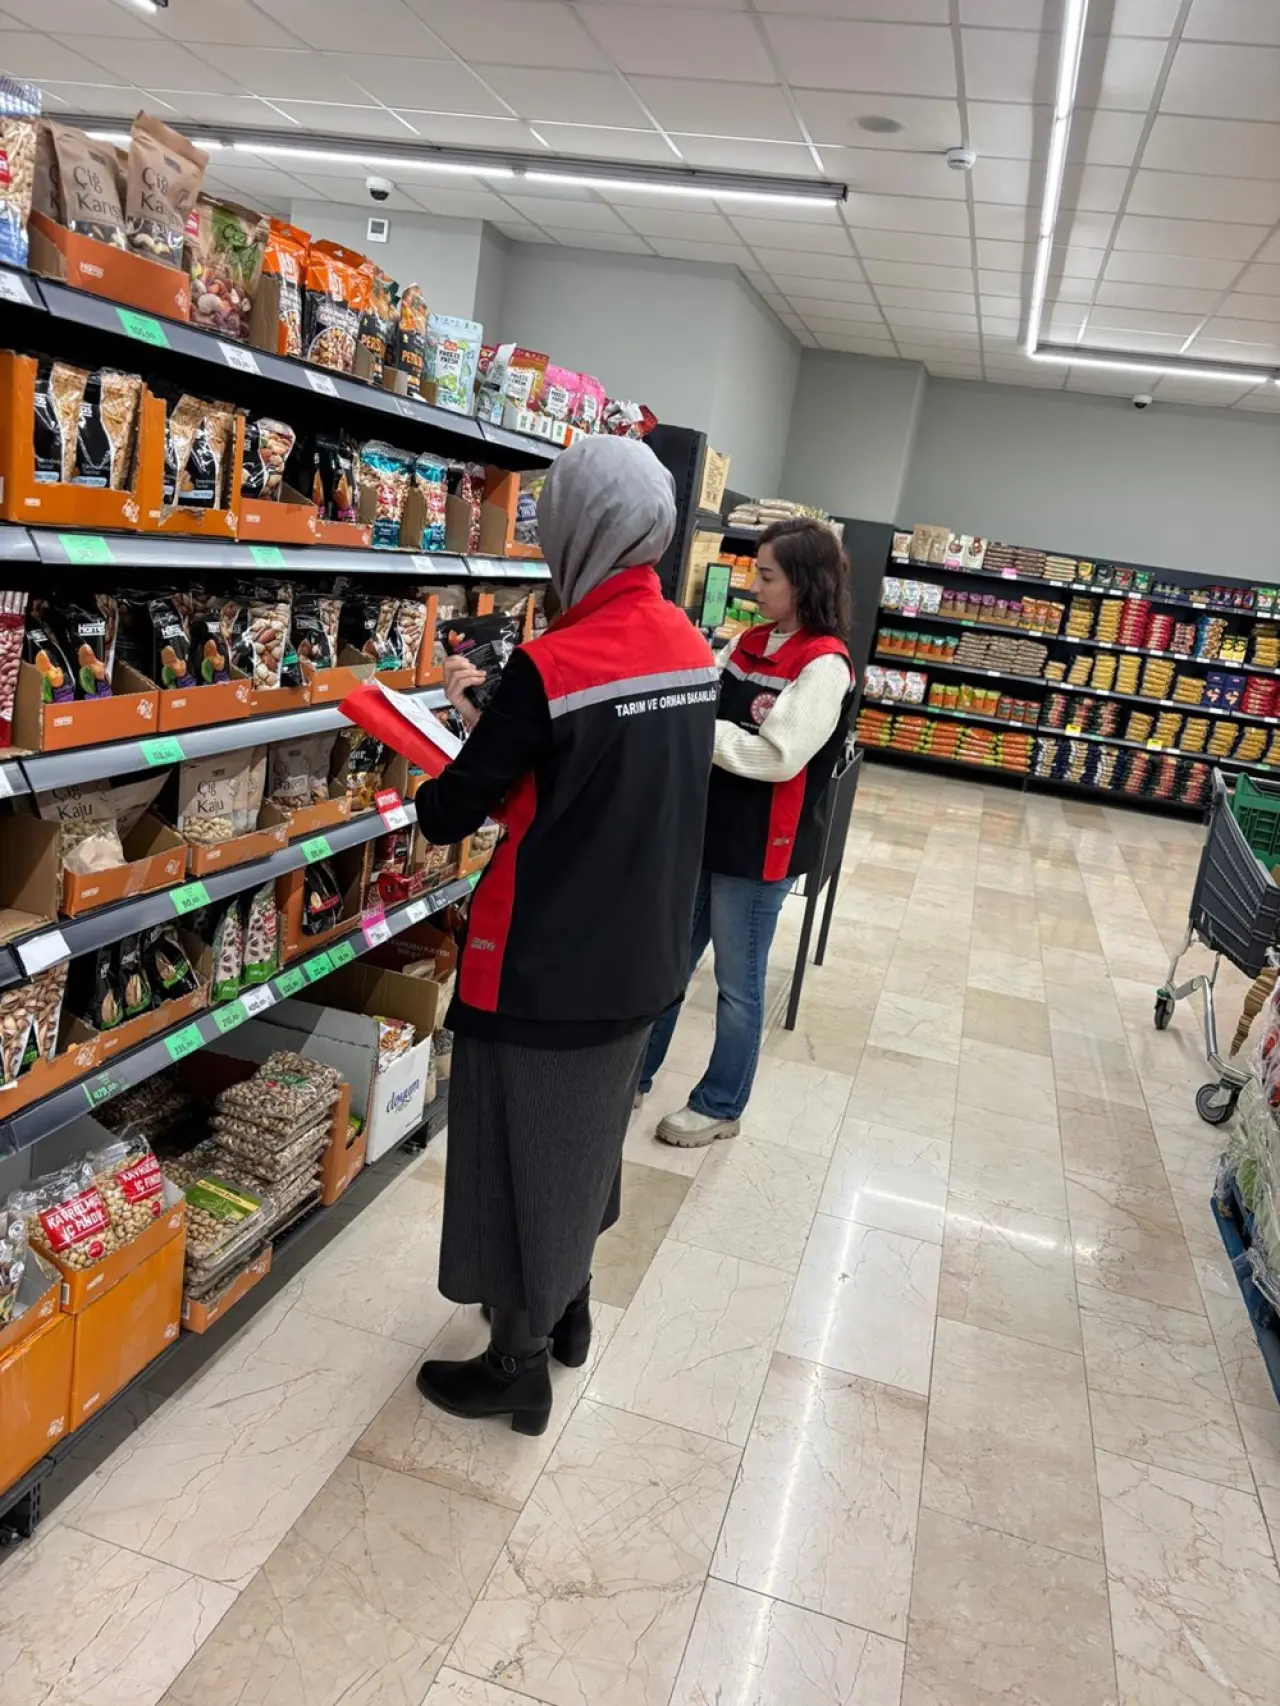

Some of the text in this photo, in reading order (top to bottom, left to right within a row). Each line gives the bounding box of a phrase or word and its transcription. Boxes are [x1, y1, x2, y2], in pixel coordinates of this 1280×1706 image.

[614, 700, 646, 717] TARIM
[647, 698, 658, 711] VE
[659, 694, 687, 709] ORMAN
[57, 803, 93, 820] Kaju
[197, 799, 225, 814] Kaju
